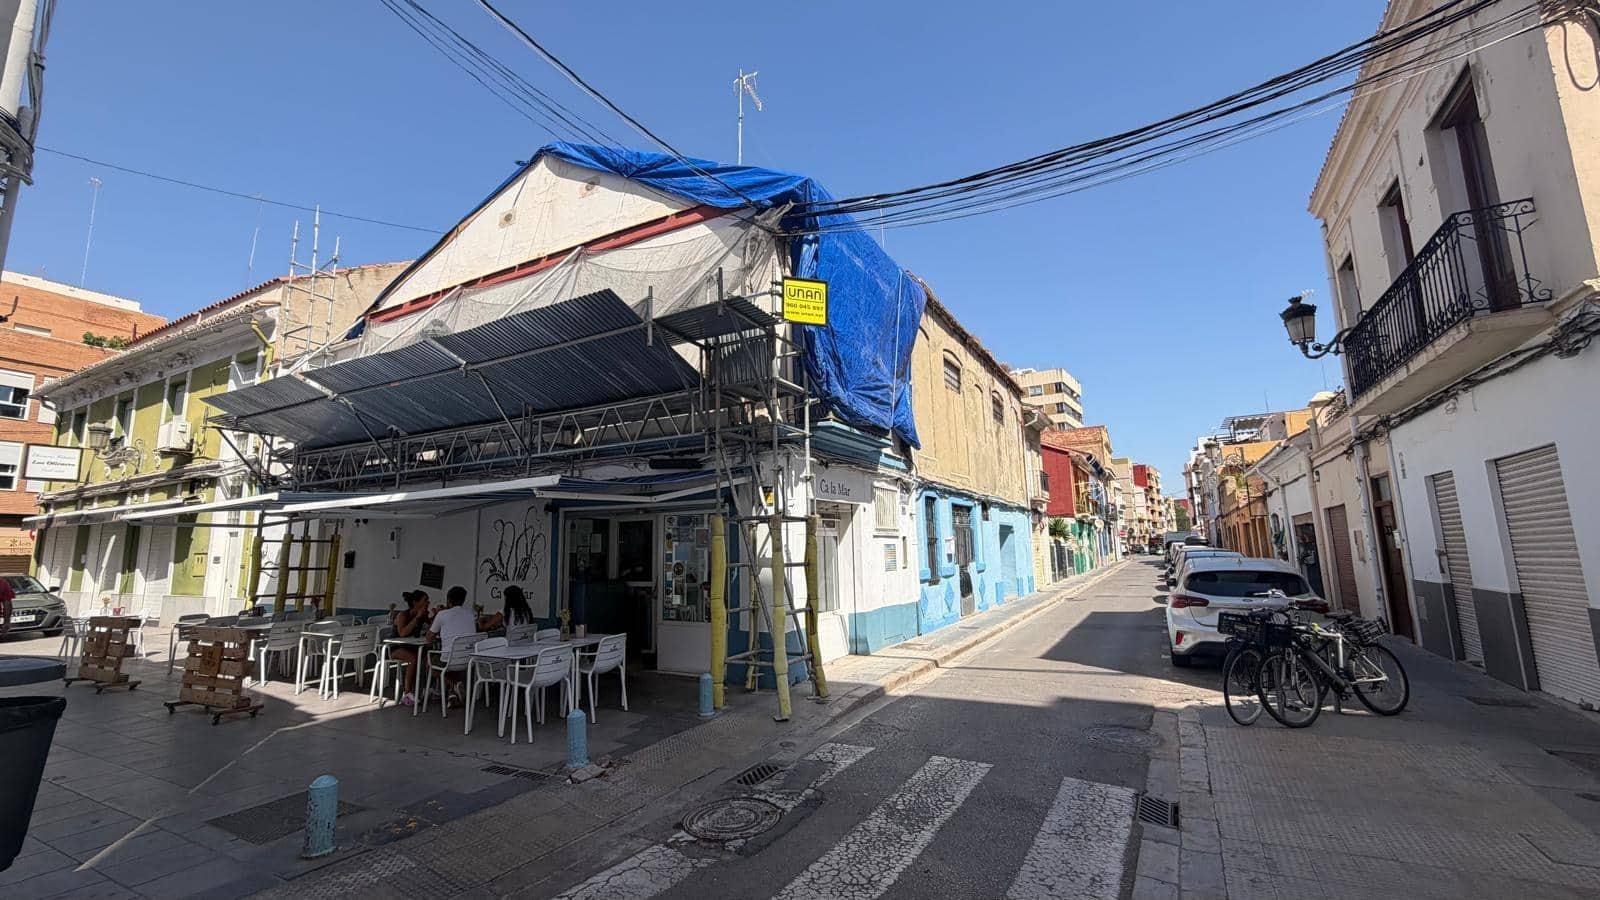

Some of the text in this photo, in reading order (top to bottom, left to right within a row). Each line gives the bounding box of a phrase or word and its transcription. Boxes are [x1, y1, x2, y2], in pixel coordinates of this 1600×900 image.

[820, 478, 851, 497] Ca la Mar
